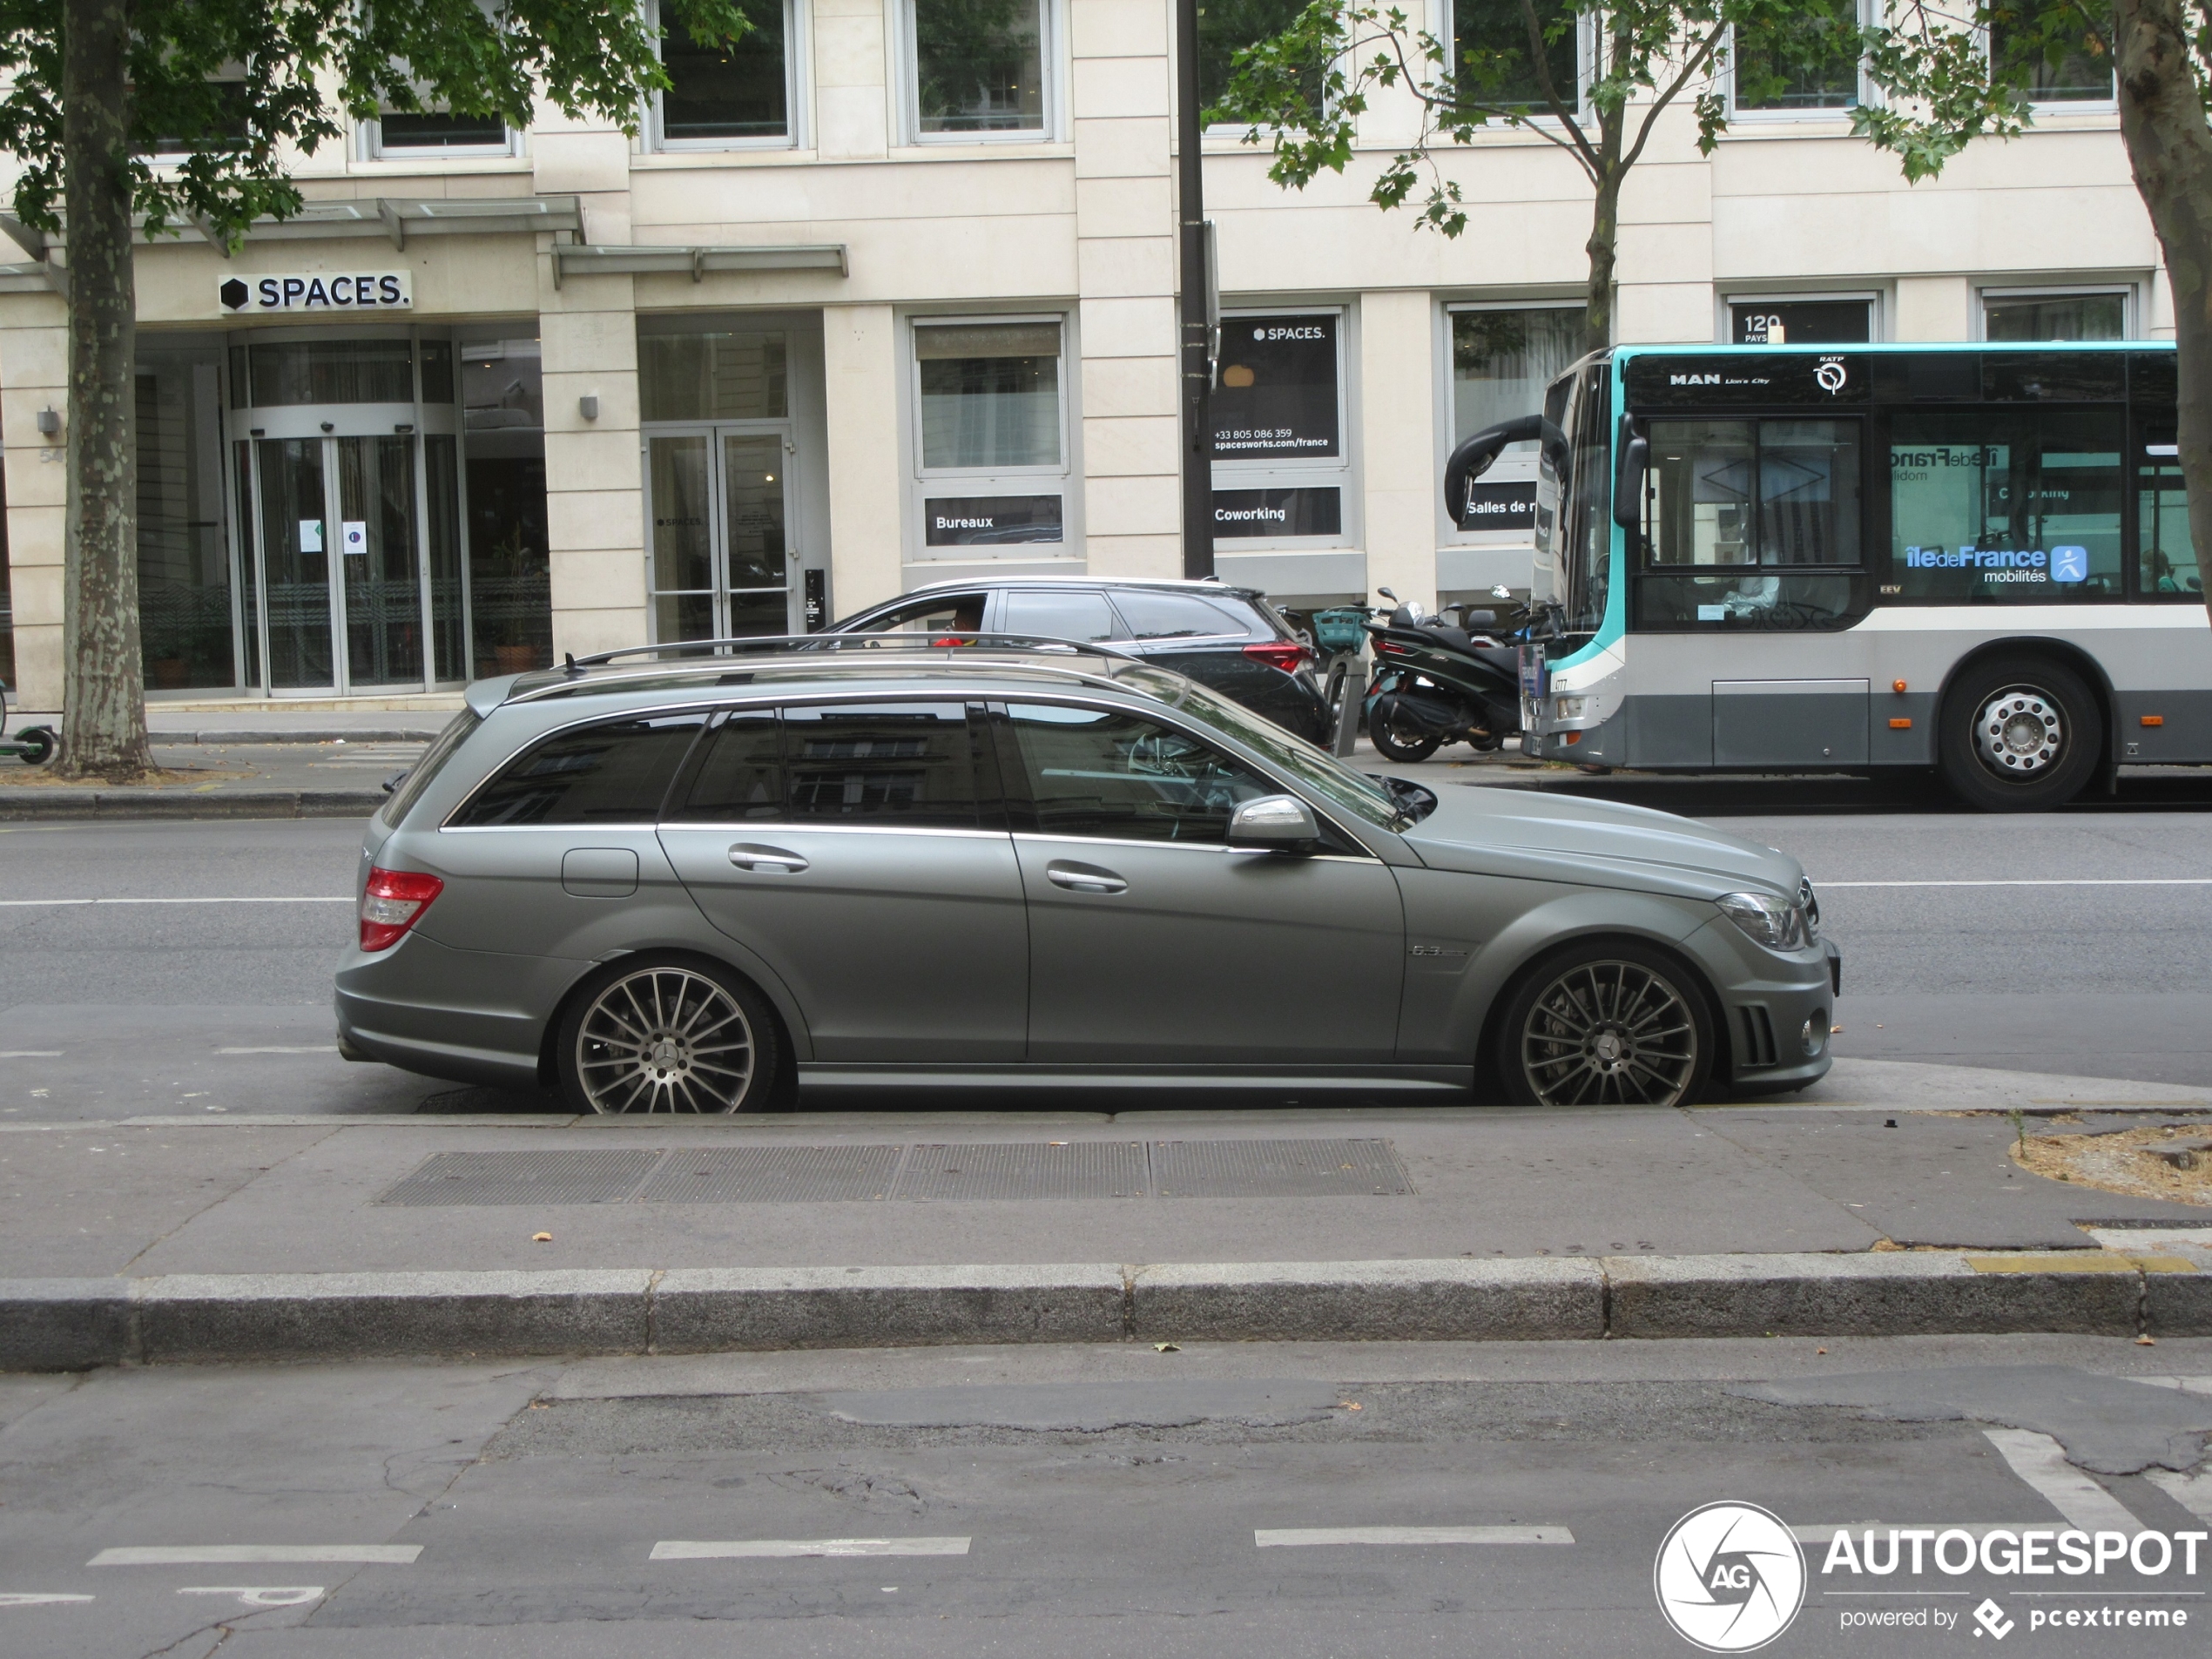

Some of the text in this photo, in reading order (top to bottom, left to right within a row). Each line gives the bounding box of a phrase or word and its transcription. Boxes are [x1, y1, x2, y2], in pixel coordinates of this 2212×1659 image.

[258, 275, 410, 307] SPACES.
[1268, 327, 1325, 341] SPACES.
[1670, 374, 1721, 385] MAN
[1215, 428, 1292, 440] +33 805 086 359
[1215, 437, 1328, 450] spacesworks.com/france
[40, 448, 64, 463] 54
[1215, 507, 1285, 521] Coworking
[1468, 501, 1507, 514] Salles
[1510, 501, 1526, 513] de
[936, 516, 994, 529] Bureaux
[1984, 570, 2047, 583] mobilités
[1879, 584, 1902, 595] EEV
